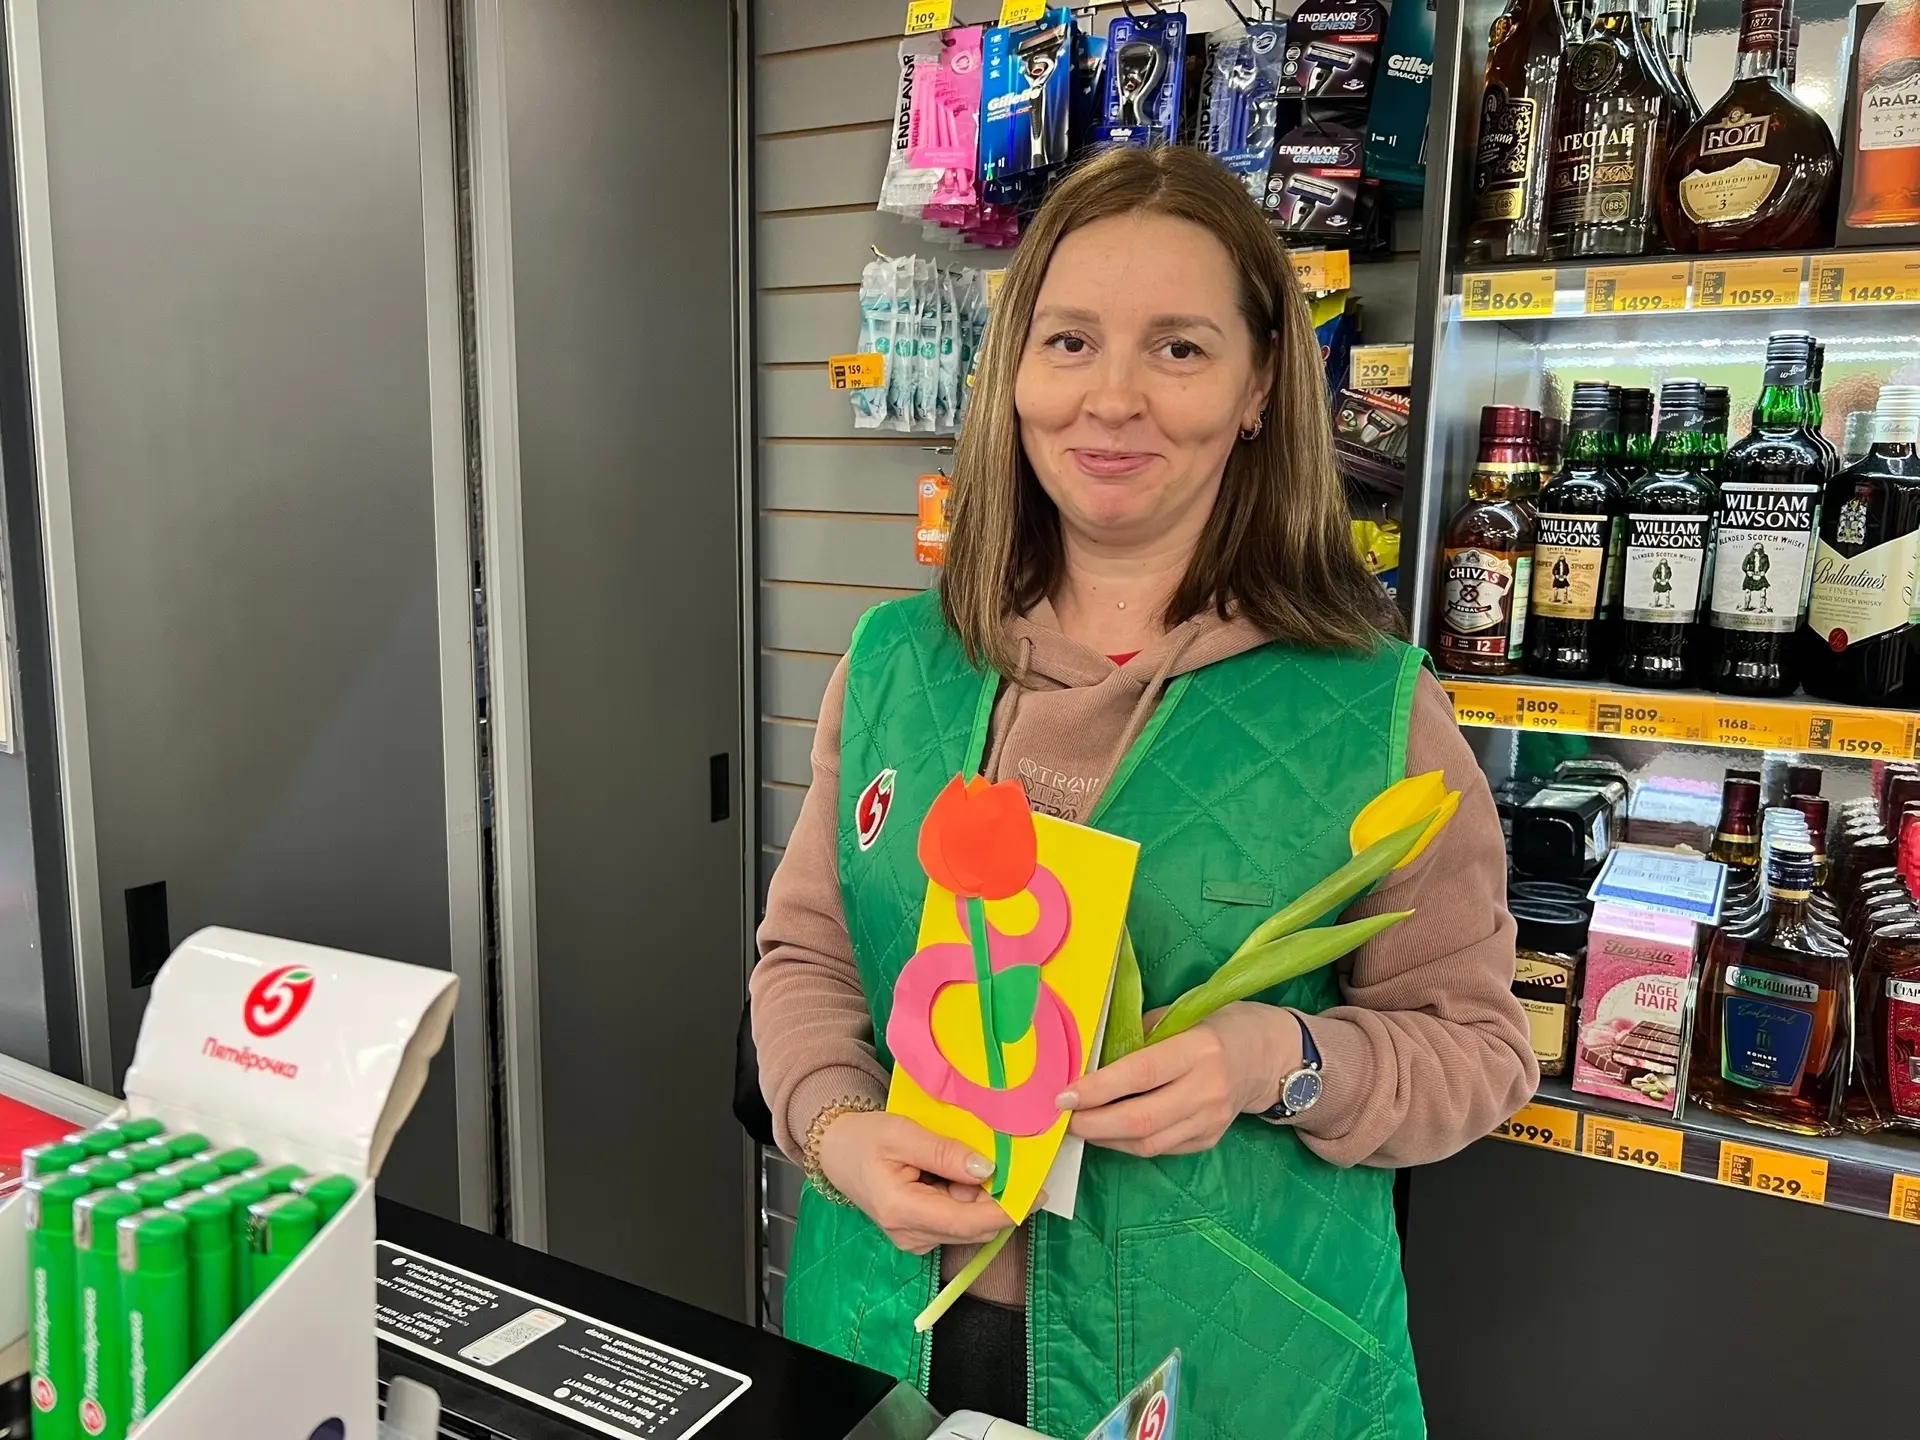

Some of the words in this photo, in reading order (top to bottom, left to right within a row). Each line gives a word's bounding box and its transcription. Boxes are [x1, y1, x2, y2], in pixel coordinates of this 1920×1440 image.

[914, 12, 935, 25] 109
[1009, 7, 1029, 18] 1019
[1297, 12, 1358, 23] ENDEAVOR
[1310, 21, 1357, 31] GENESIS
[1750, 17, 1774, 28] 1877
[1279, 86, 1286, 94] 2
[897, 54, 915, 150] ENDEAVOR
[1868, 92, 1920, 108] ARAR
[911, 109, 921, 148] WOMEN
[1893, 125, 1904, 138] 5
[1707, 122, 1762, 149] НОЙ
[1279, 145, 1340, 156] ENDEAVOR
[1292, 155, 1338, 165] GENESIS
[1689, 173, 1769, 190] ТРАДИЦИОННЫЙ
[1605, 201, 1625, 211] 1885
[1718, 199, 1727, 211] 3
[1822, 270, 1837, 278] ВЫ-
[1703, 286, 1714, 295] ДА
[1821, 283, 1832, 292] ДА
[1848, 286, 1896, 301] 1449
[1491, 292, 1533, 310] 869
[1619, 295, 1663, 311] 1499
[1729, 289, 1775, 304] 1059
[848, 365, 861, 374] 159
[1362, 364, 1389, 378] 299
[850, 380, 862, 388] 199
[1725, 493, 1809, 512] WILLIAM
[1719, 510, 1811, 529] LAWSON'S
[1540, 520, 1598, 534] WILLIAM
[1635, 521, 1700, 535] WILLIAM
[1537, 531, 1601, 546] LAWSON'S
[1631, 534, 1702, 548] LAWSON'S
[1719, 535, 1745, 546] BLENDED
[1747, 533, 1779, 542] SCOTCH
[1781, 536, 1806, 549] WHISKY
[919, 553, 925, 562] 2
[1632, 552, 1655, 561] BLENDED
[1449, 567, 1500, 584] CHIVAS
[1812, 556, 1887, 590] Ballantine's
[1828, 587, 1860, 596] FINEST
[1833, 596, 1857, 604] SCOTCH
[1857, 598, 1883, 607] WHISKY
[1476, 640, 1491, 652] 12
[1526, 700, 1559, 714] 809
[1458, 709, 1495, 722] 1999
[1624, 708, 1658, 722] 809
[1532, 717, 1557, 727] 899
[1717, 718, 1748, 730] 1168
[1811, 719, 1826, 727] ВЫ-
[1630, 725, 1658, 736] 899
[1810, 731, 1822, 739] ДА
[1811, 725, 1823, 733] ГО-
[1718, 734, 1747, 745] 1299
[1837, 738, 1883, 754] 1599
[1636, 982, 1679, 998] ANGEL
[1731, 968, 1812, 1000] СТАРЕЙШИНА
[1531, 1003, 1554, 1011] COFFEE
[1634, 992, 1678, 1013] HAIR
[201, 1036, 300, 1080] Пятёрочка
[1746, 1050, 1778, 1061] КОНЬЯК
[1511, 1122, 1553, 1144] 999
[1617, 1146, 1659, 1166] 549
[1733, 1162, 1744, 1170] ГО-
[1755, 1174, 1801, 1196] 829
[1905, 1202, 1916, 1210] ДА
[404, 1262, 458, 1283] дня/вечера!
[392, 1276, 446, 1298] приложении
[398, 1286, 424, 1299] карту
[455, 1281, 498, 1299] хорошего
[451, 1299, 466, 1307] 7%
[452, 1288, 488, 1305] Спасибо
[381, 1307, 399, 1316] или
[423, 1297, 468, 1318] Оформите
[412, 1312, 451, 1328] картой?
[396, 1322, 432, 1340] Можете
[415, 1321, 440, 1334] через
[585, 1329, 613, 1343] товар
[602, 1344, 650, 1366] внимание
[613, 1340, 669, 1364] акционный
[668, 1361, 692, 1373] наш
[692, 1369, 706, 1378] на
[650, 1363, 699, 1385] Обратите
[563, 1379, 597, 1394] пакет?
[583, 1373, 616, 1389] карта
[700, 1381, 709, 1389] 4.
[616, 1386, 638, 1398] есть
[598, 1392, 633, 1409] нужен
[638, 1395, 657, 1406] вас
[570, 1394, 644, 1428] Здравствуйте!
[633, 1406, 655, 1419] Вам
[669, 1407, 679, 1415] 3.
[658, 1416, 668, 1424] 2.
[647, 1425, 656, 1433] 1.
